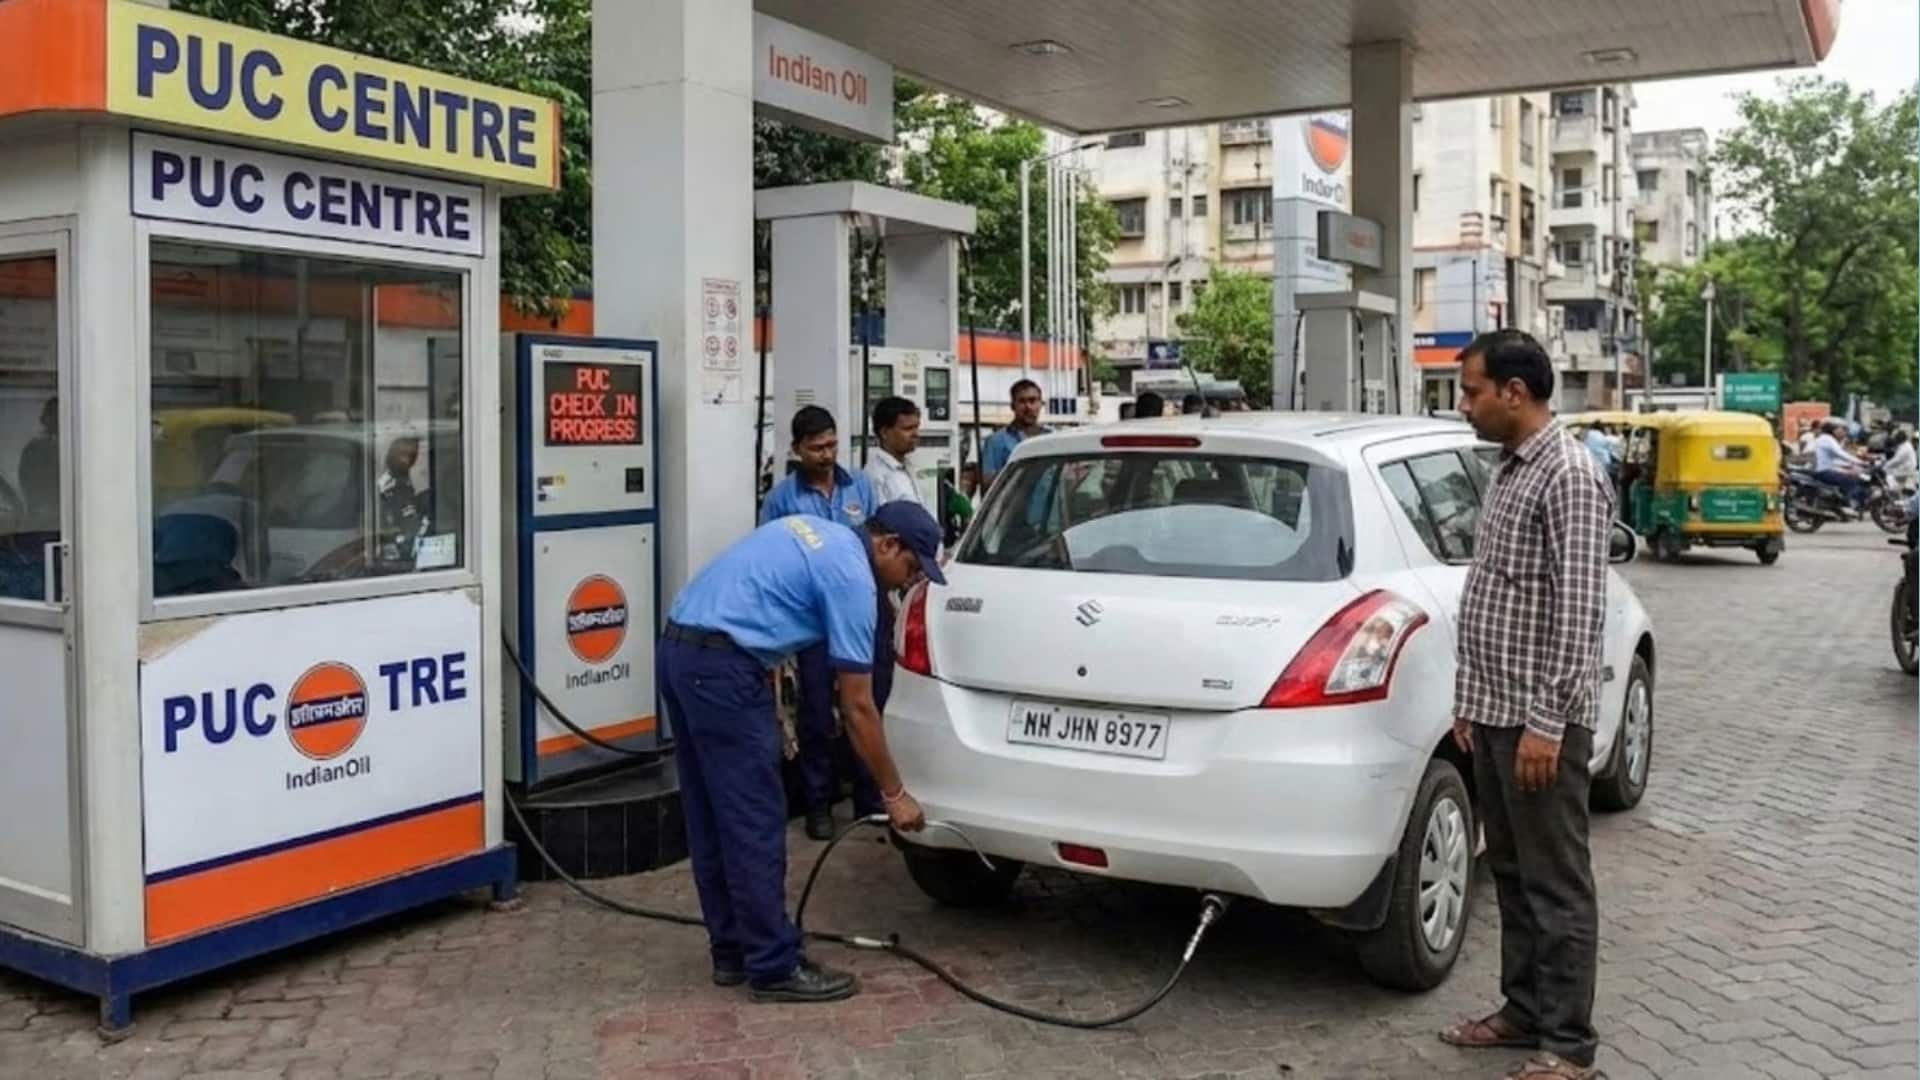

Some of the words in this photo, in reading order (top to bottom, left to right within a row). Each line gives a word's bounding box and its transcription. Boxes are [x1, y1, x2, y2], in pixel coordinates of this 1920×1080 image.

[769, 43, 837, 97] Indian
[841, 69, 868, 105] Oil
[136, 24, 284, 121] PUC
[306, 63, 538, 168] CENTRE
[151, 150, 264, 213] PUC
[283, 172, 471, 241] CENTRE
[576, 368, 610, 391] PUC
[550, 393, 605, 417] CHECK
[616, 394, 637, 417] IN
[550, 418, 636, 442] PROGRESS
[565, 661, 630, 690] IndianOil
[163, 683, 277, 753] PUC
[379, 651, 467, 712] TRE
[1057, 715, 1099, 743] JHN
[1104, 720, 1162, 749] 8977
[286, 755, 370, 790] IndianOil
